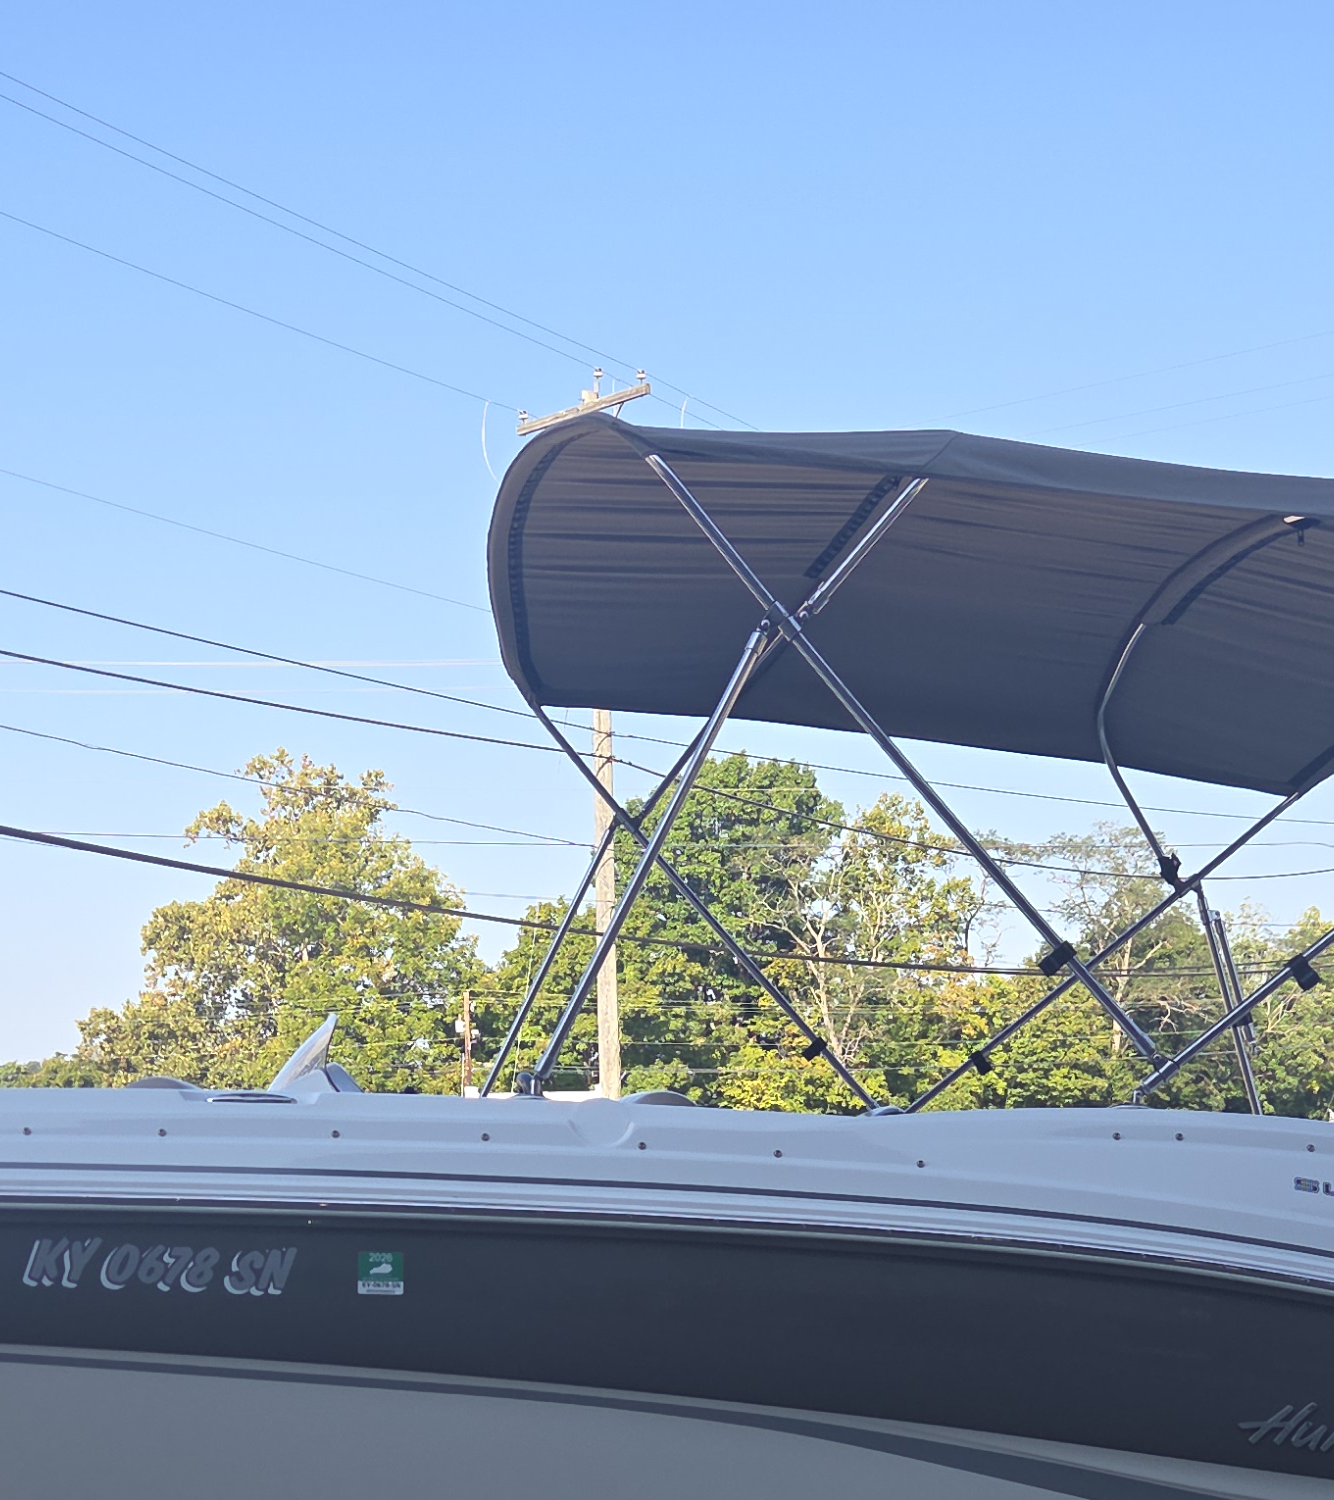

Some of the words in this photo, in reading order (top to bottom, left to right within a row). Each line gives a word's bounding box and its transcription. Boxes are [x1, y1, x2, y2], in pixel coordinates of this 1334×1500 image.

[23, 1237, 103, 1288] KY
[100, 1243, 220, 1293] 0678
[223, 1247, 297, 1296] SN
